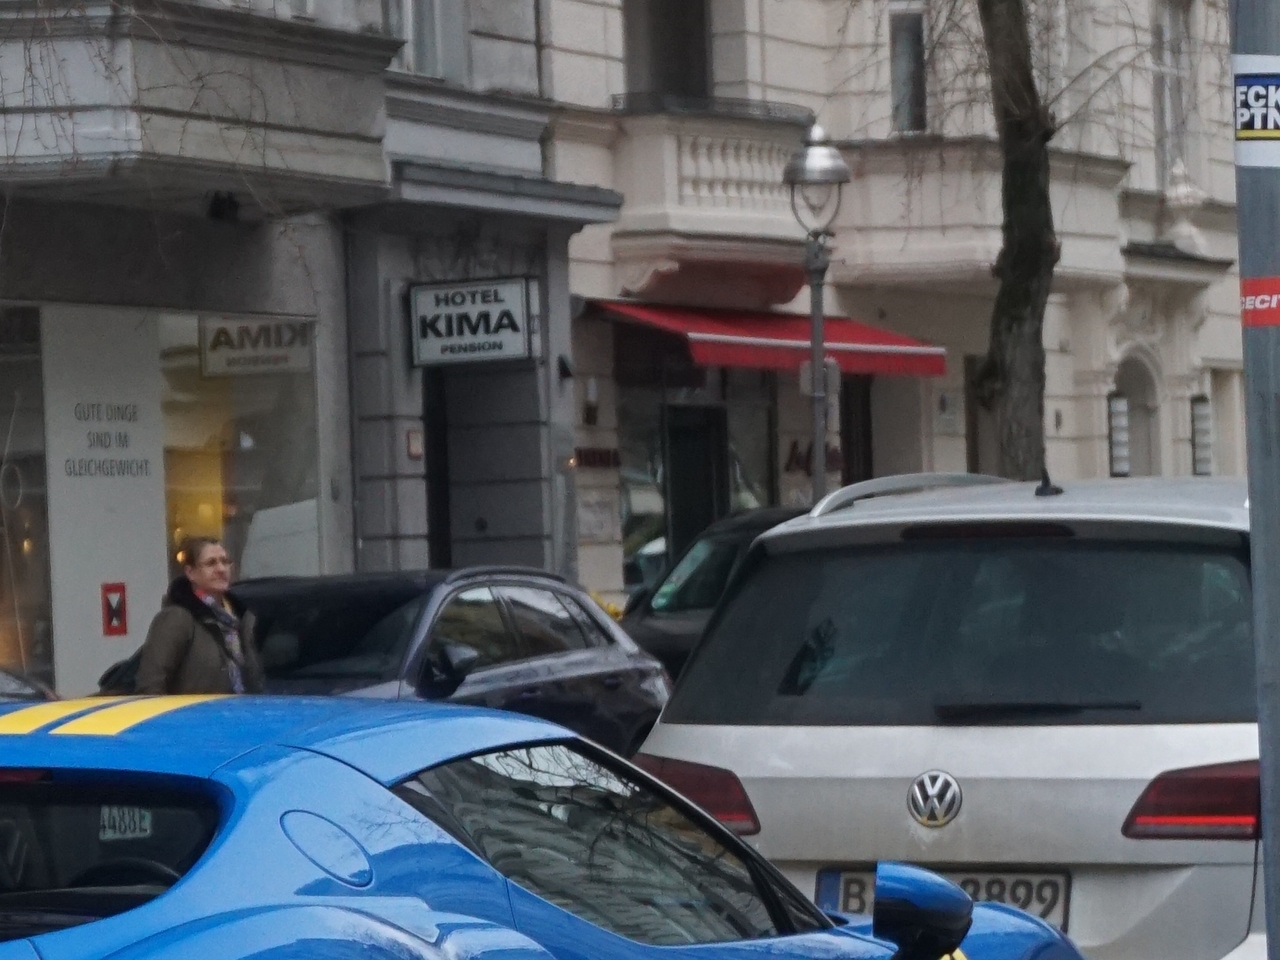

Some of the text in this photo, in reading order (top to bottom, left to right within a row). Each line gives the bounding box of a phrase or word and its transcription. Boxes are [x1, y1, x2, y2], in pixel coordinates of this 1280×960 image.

[434, 289, 504, 307] HOTEL
[420, 309, 520, 338] KIMA
[440, 341, 503, 354] PENSION
[74, 403, 138, 421] GUTE DINGE
[87, 431, 129, 448] SIND IM
